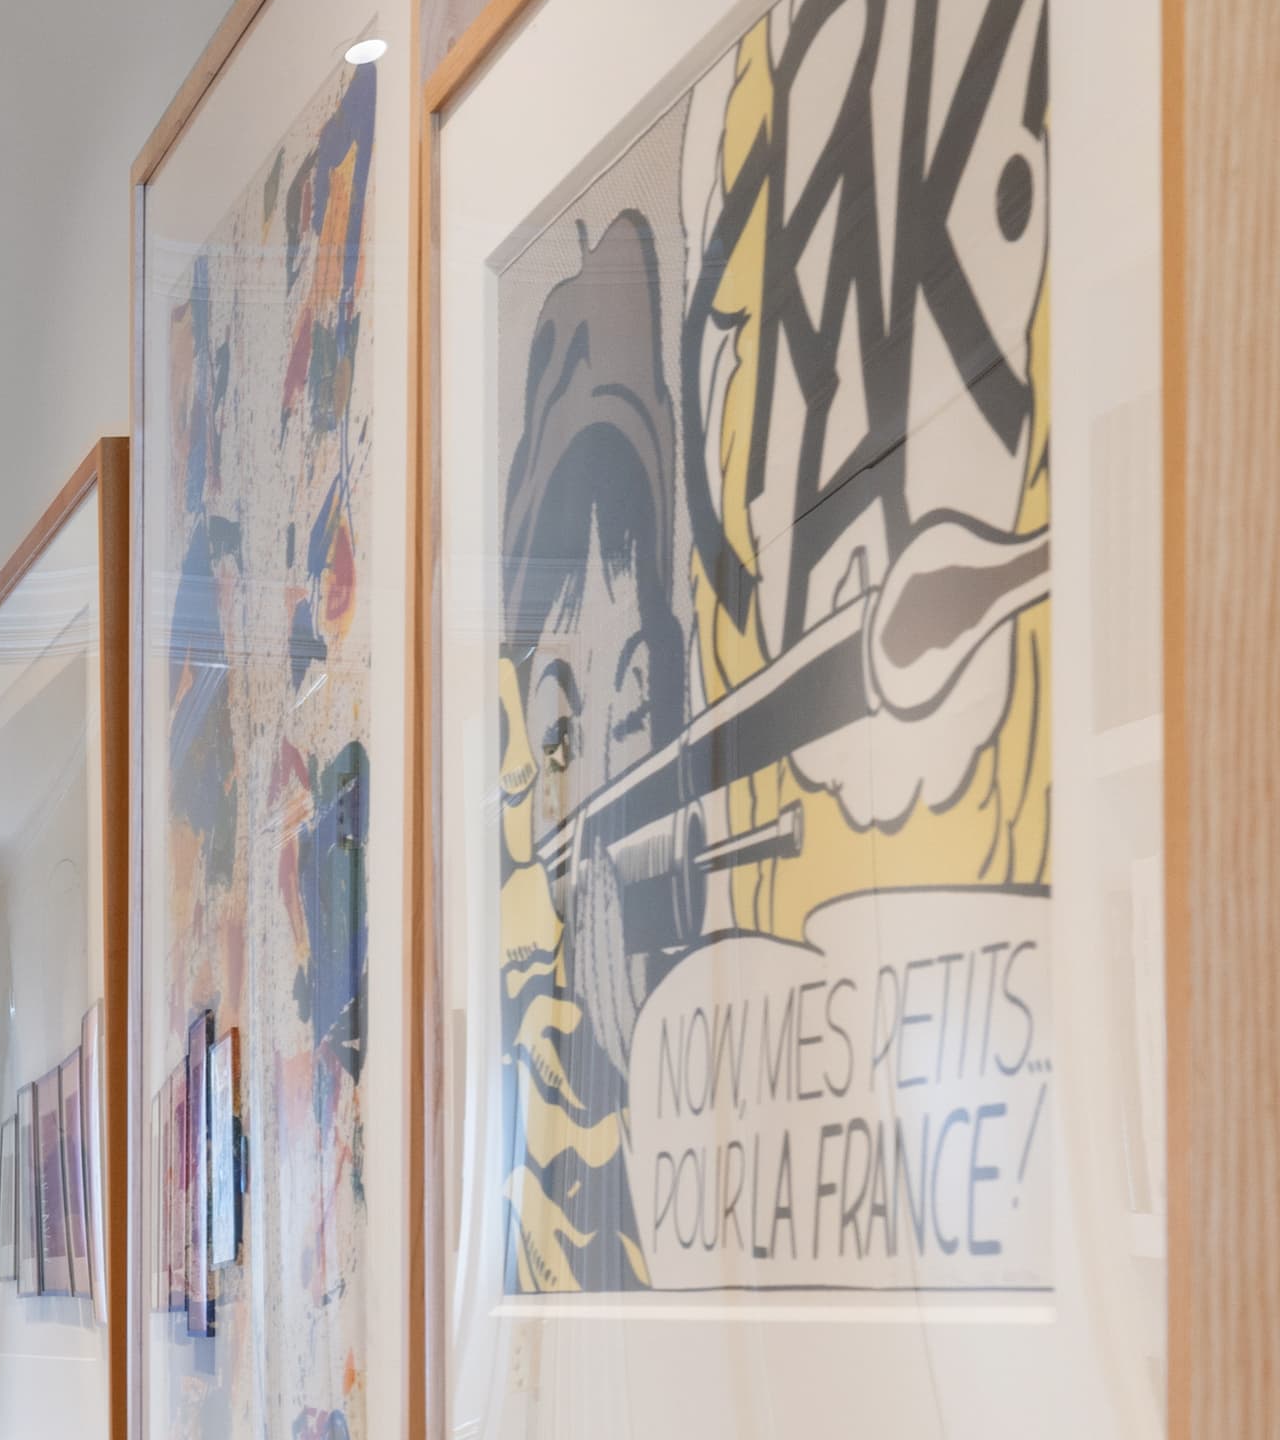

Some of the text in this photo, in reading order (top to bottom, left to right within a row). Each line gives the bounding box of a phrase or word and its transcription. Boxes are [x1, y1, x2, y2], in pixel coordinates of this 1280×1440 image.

[757, 978, 858, 1105] MES
[654, 1141, 746, 1255] POUR
[752, 1129, 798, 1260] LA
